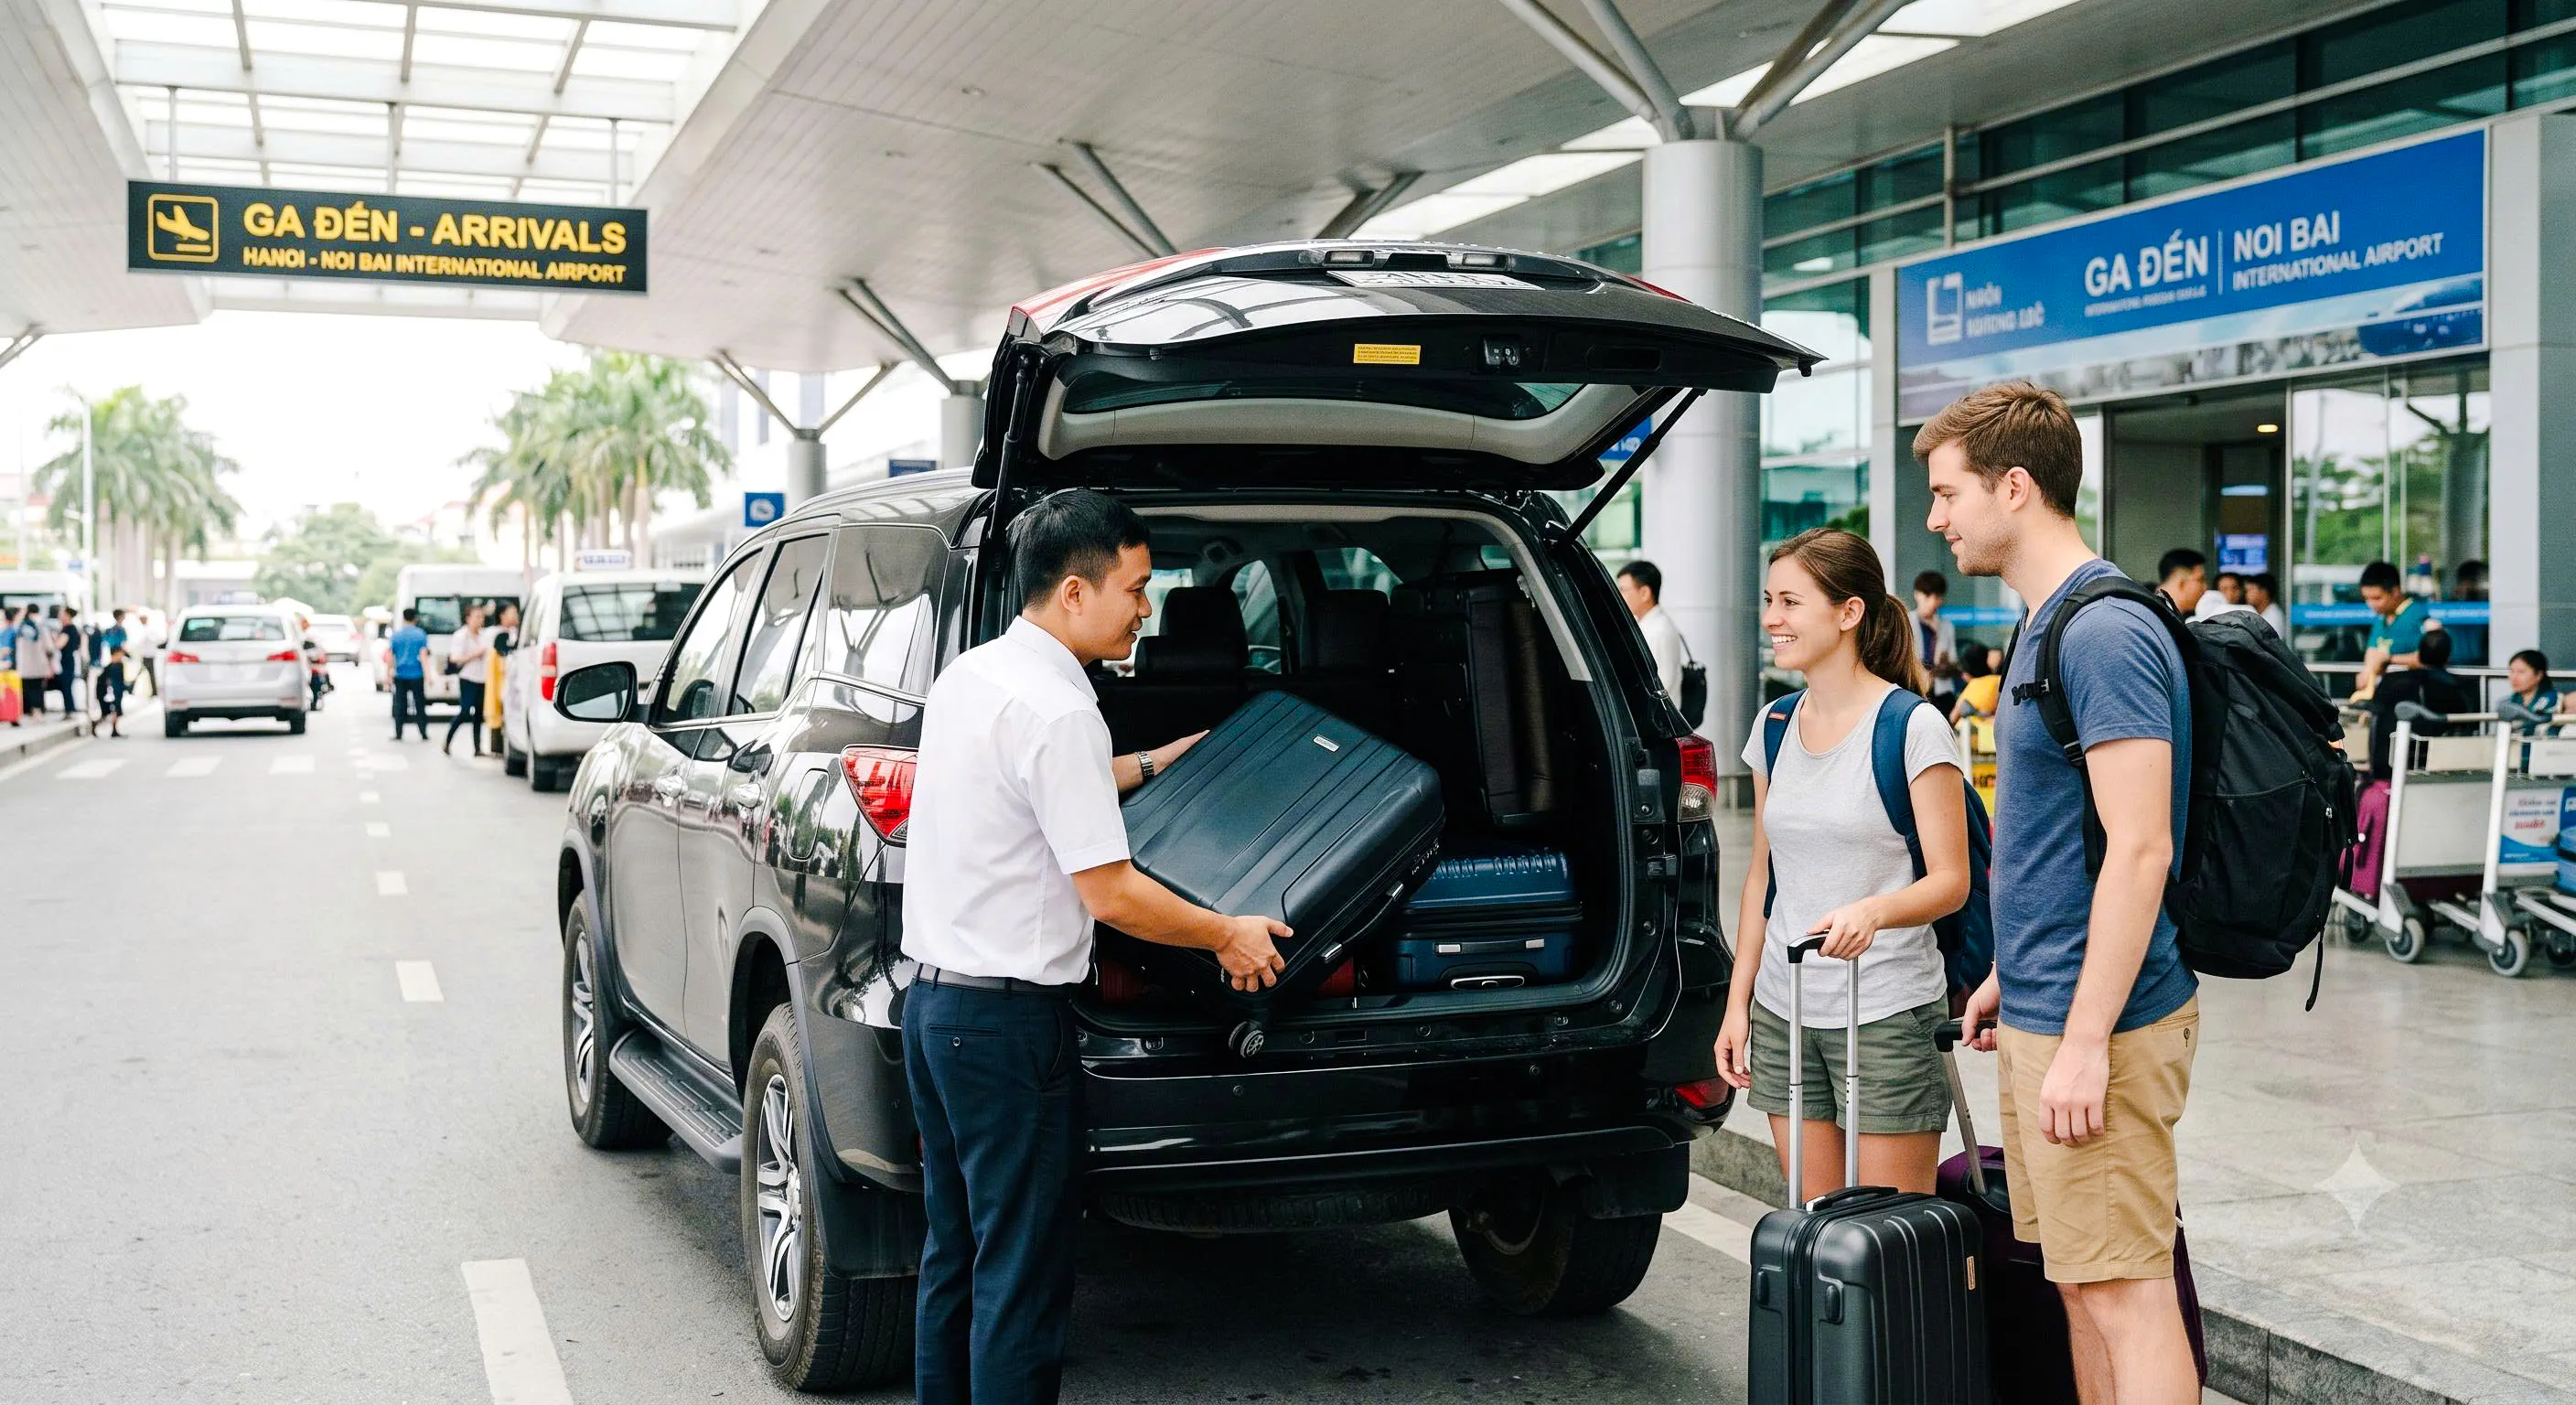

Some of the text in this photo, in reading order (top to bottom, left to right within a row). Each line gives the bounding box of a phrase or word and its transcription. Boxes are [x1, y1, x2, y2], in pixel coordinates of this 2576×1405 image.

[242, 202, 306, 239] GA
[409, 226, 425, 238] -
[431, 212, 628, 254] ARRIVALS
[2233, 210, 2341, 263] NOI BAI
[242, 246, 306, 269] HANOI
[320, 250, 356, 271] NOI
[358, 252, 393, 273] BAI
[394, 253, 544, 280] INTERNATIONAL
[544, 262, 628, 284] AIRPORT
[2084, 253, 2132, 297] GA
[2232, 231, 2444, 291] INTERNATIONAL AIRPORT
